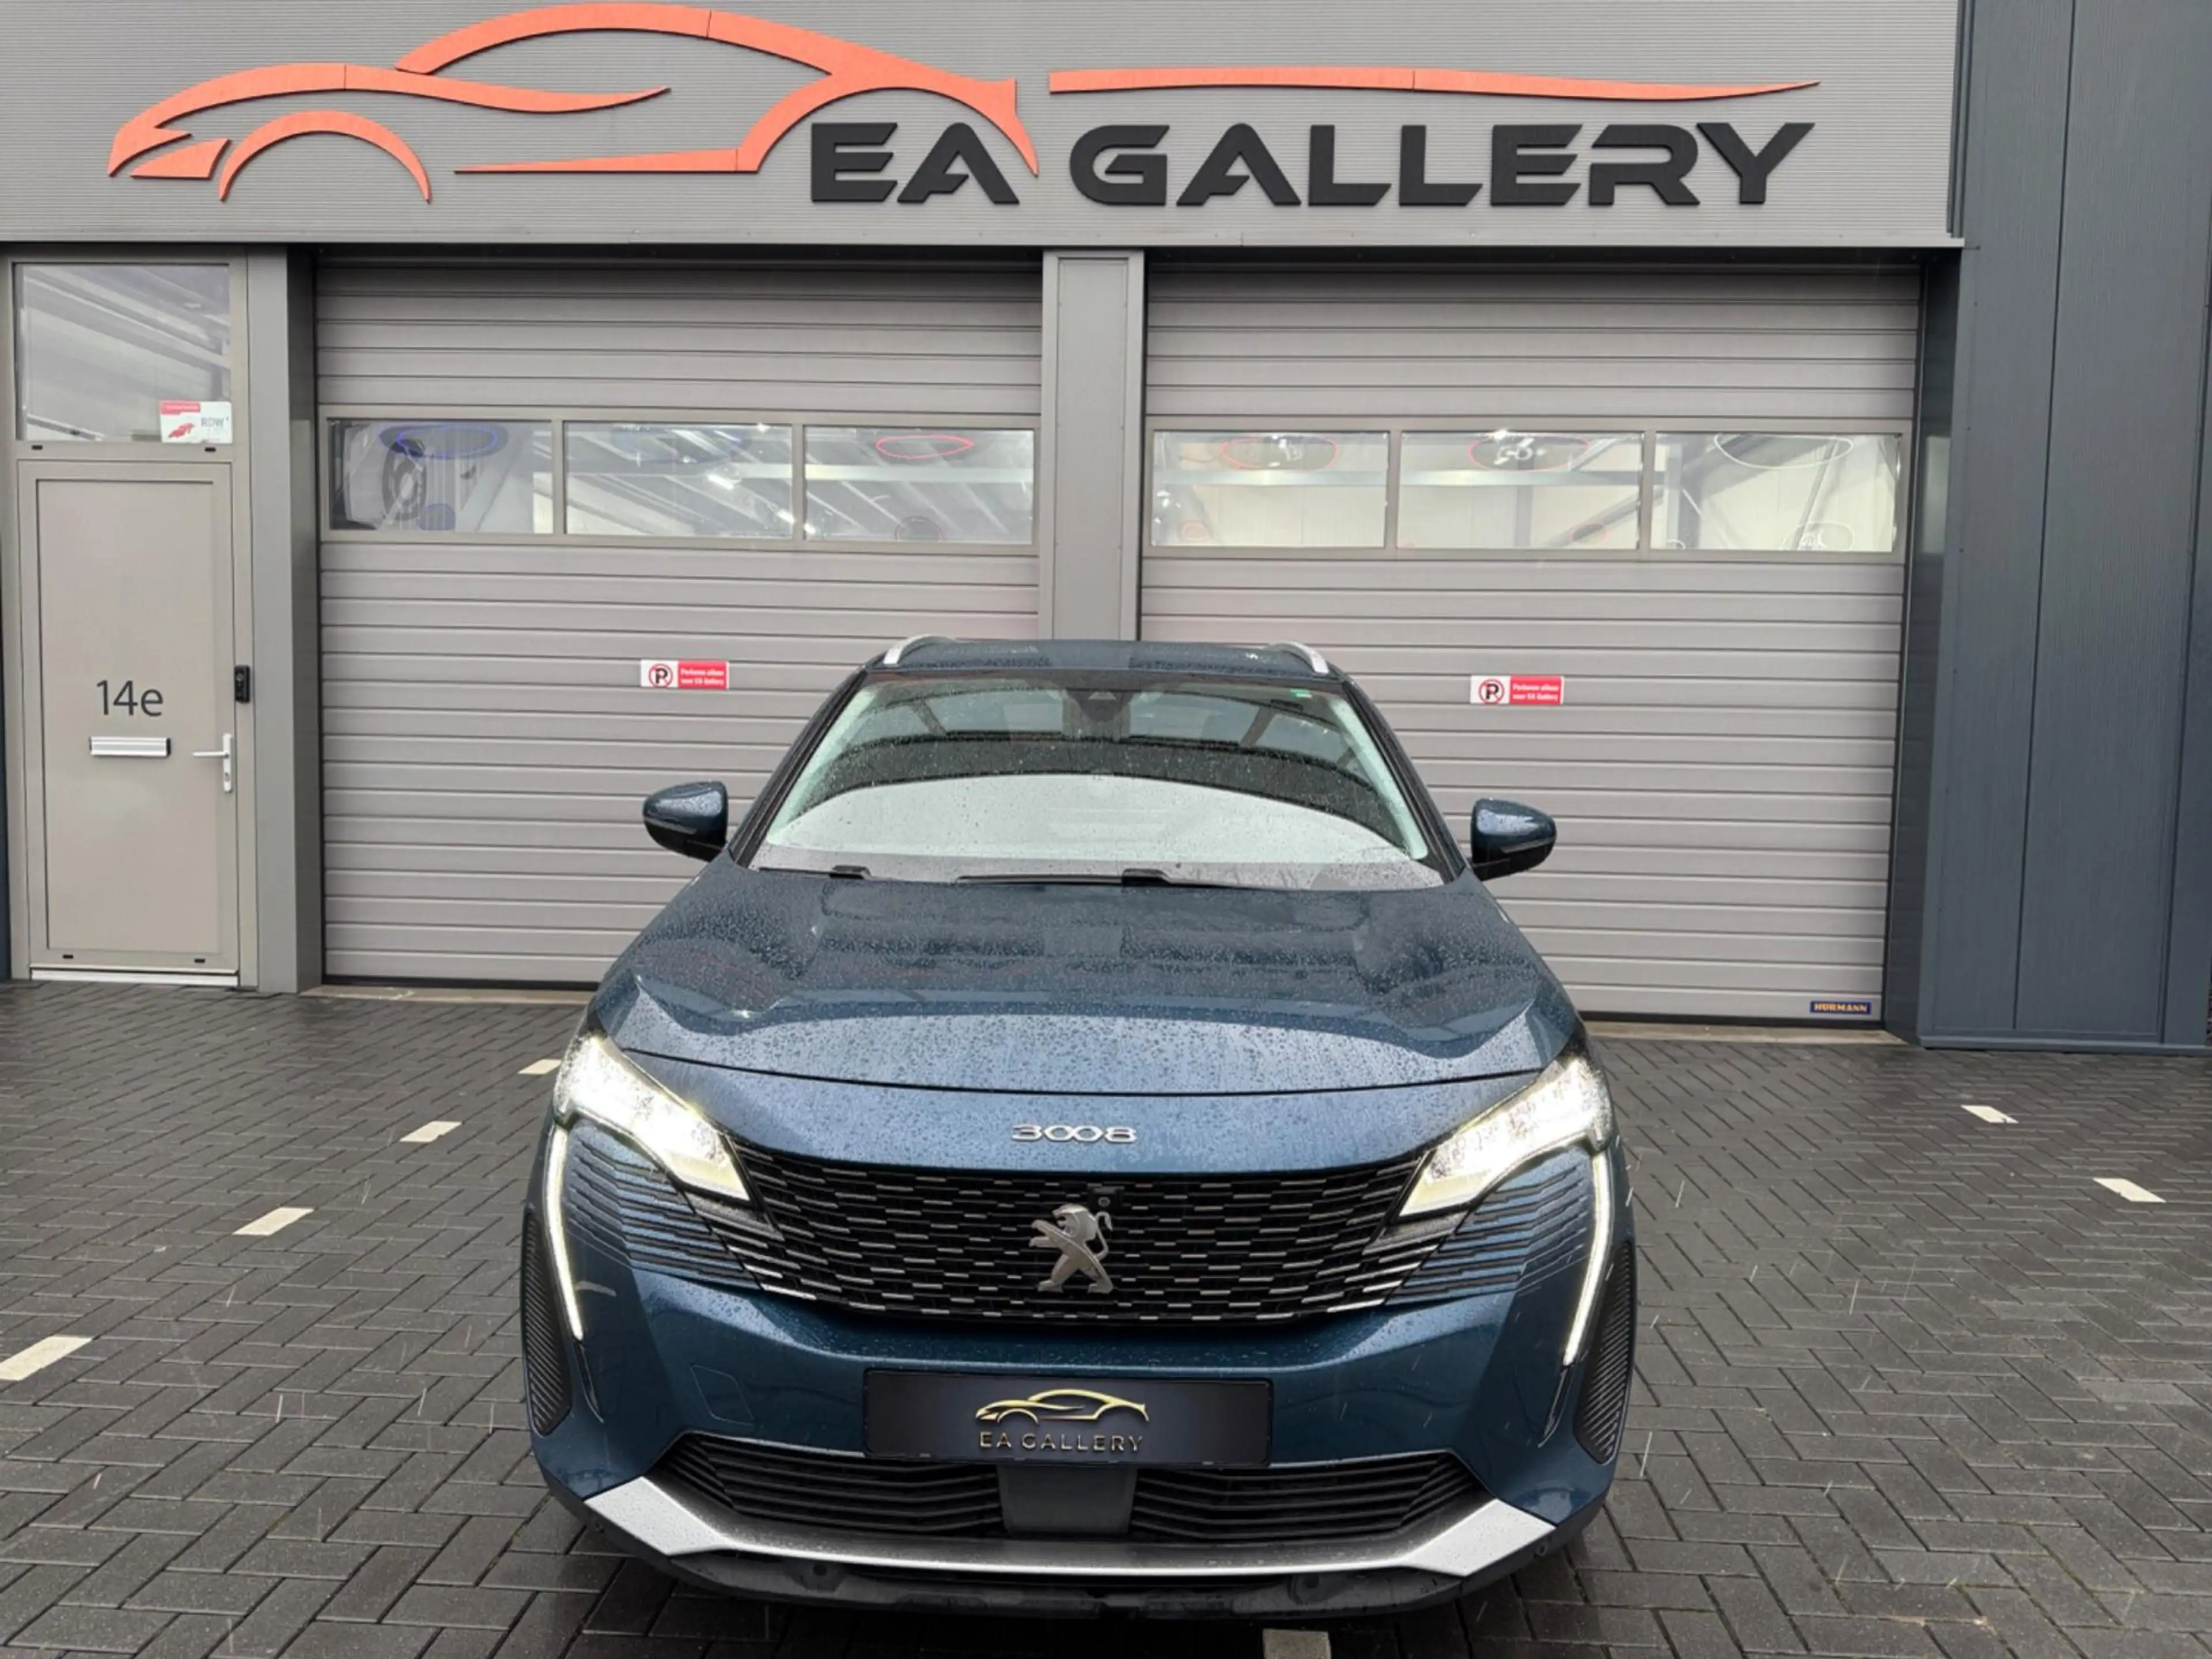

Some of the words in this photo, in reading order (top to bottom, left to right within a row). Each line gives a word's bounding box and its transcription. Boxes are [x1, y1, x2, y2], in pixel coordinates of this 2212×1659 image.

[811, 122, 1020, 205] EA
[1070, 123, 1814, 207] GALLERY
[96, 680, 164, 717] 14e
[1012, 1124, 1137, 1143] 3008
[980, 1431, 1012, 1448] EA
[1021, 1433, 1143, 1452] GALLERY
